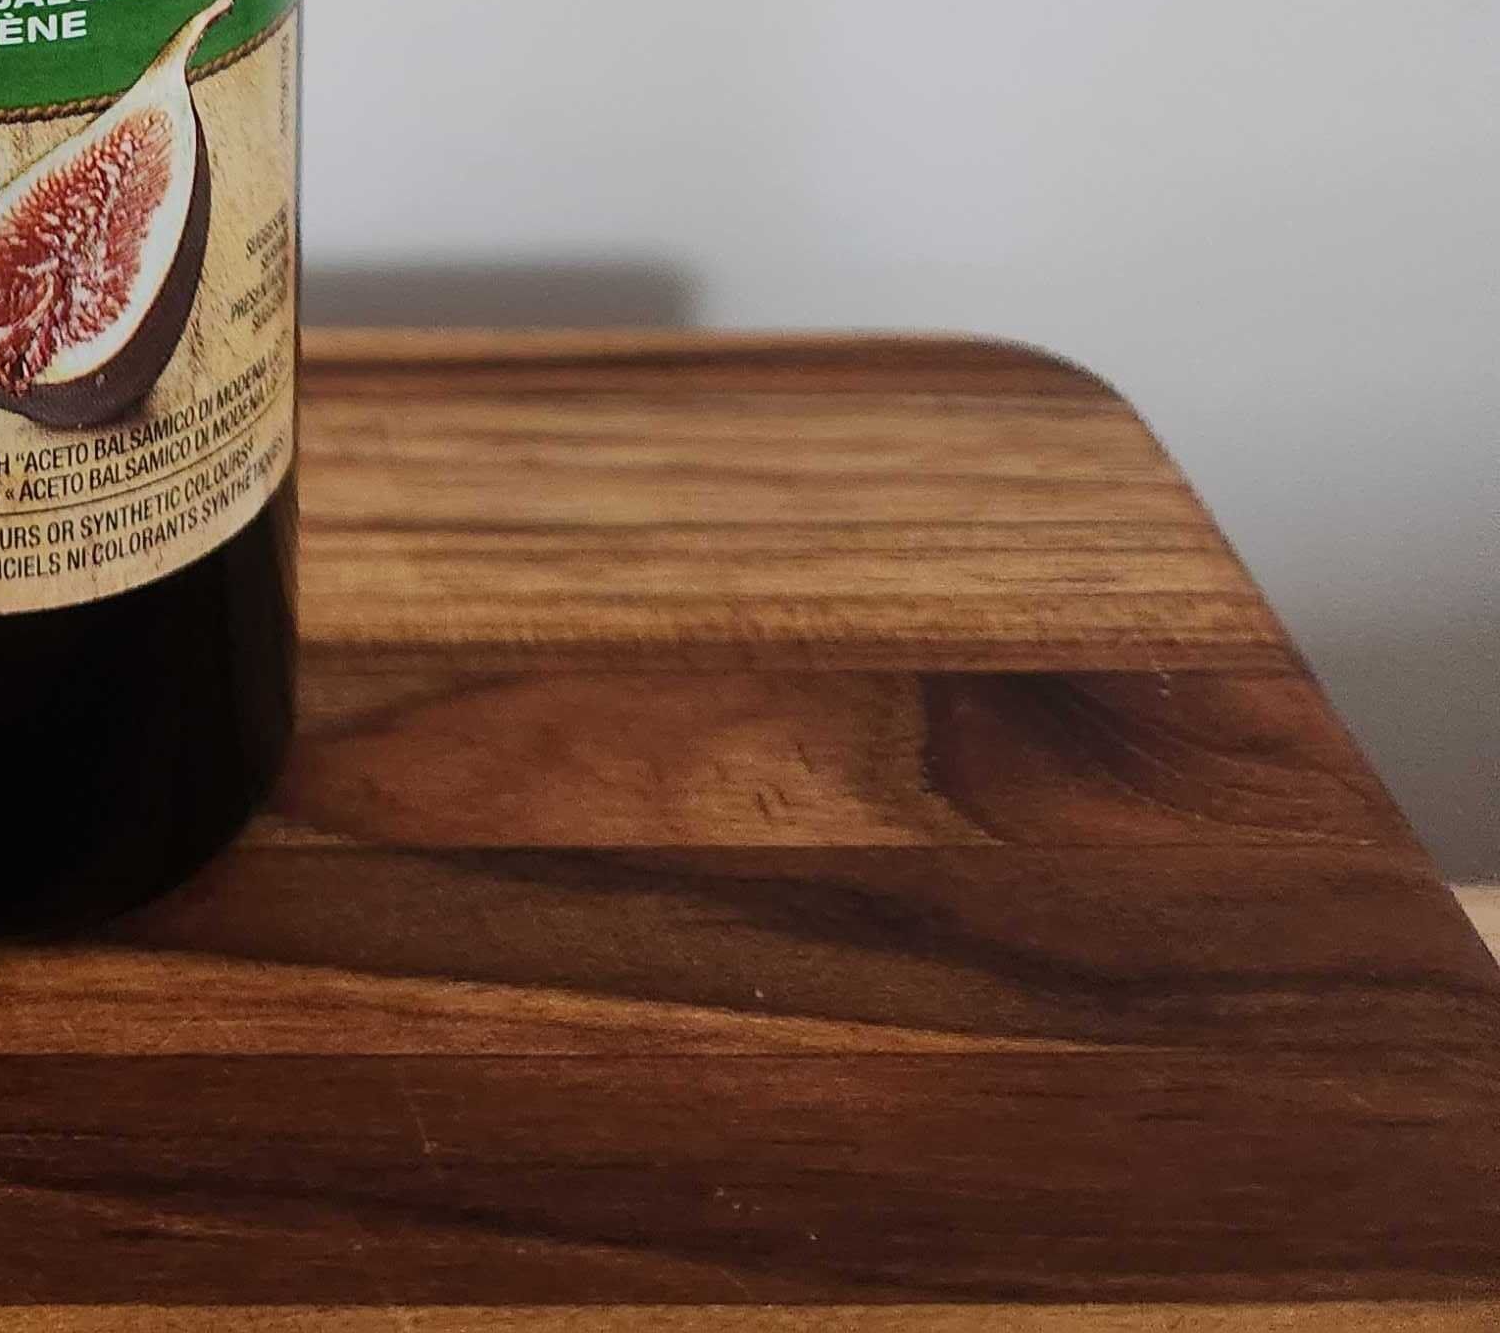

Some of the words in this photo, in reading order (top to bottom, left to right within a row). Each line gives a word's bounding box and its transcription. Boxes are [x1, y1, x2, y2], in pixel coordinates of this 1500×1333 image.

[93, 405, 195, 461] BALSAMICO
[199, 396, 214, 422] DI
[18, 472, 84, 502] ACETO
[88, 437, 192, 490] BALSAMICO
[195, 426, 210, 452] DI
[47, 517, 75, 545] OR
[80, 485, 181, 538] SYNTHETIC
[67, 548, 88, 571] NI
[92, 506, 198, 566] COLORANTS
